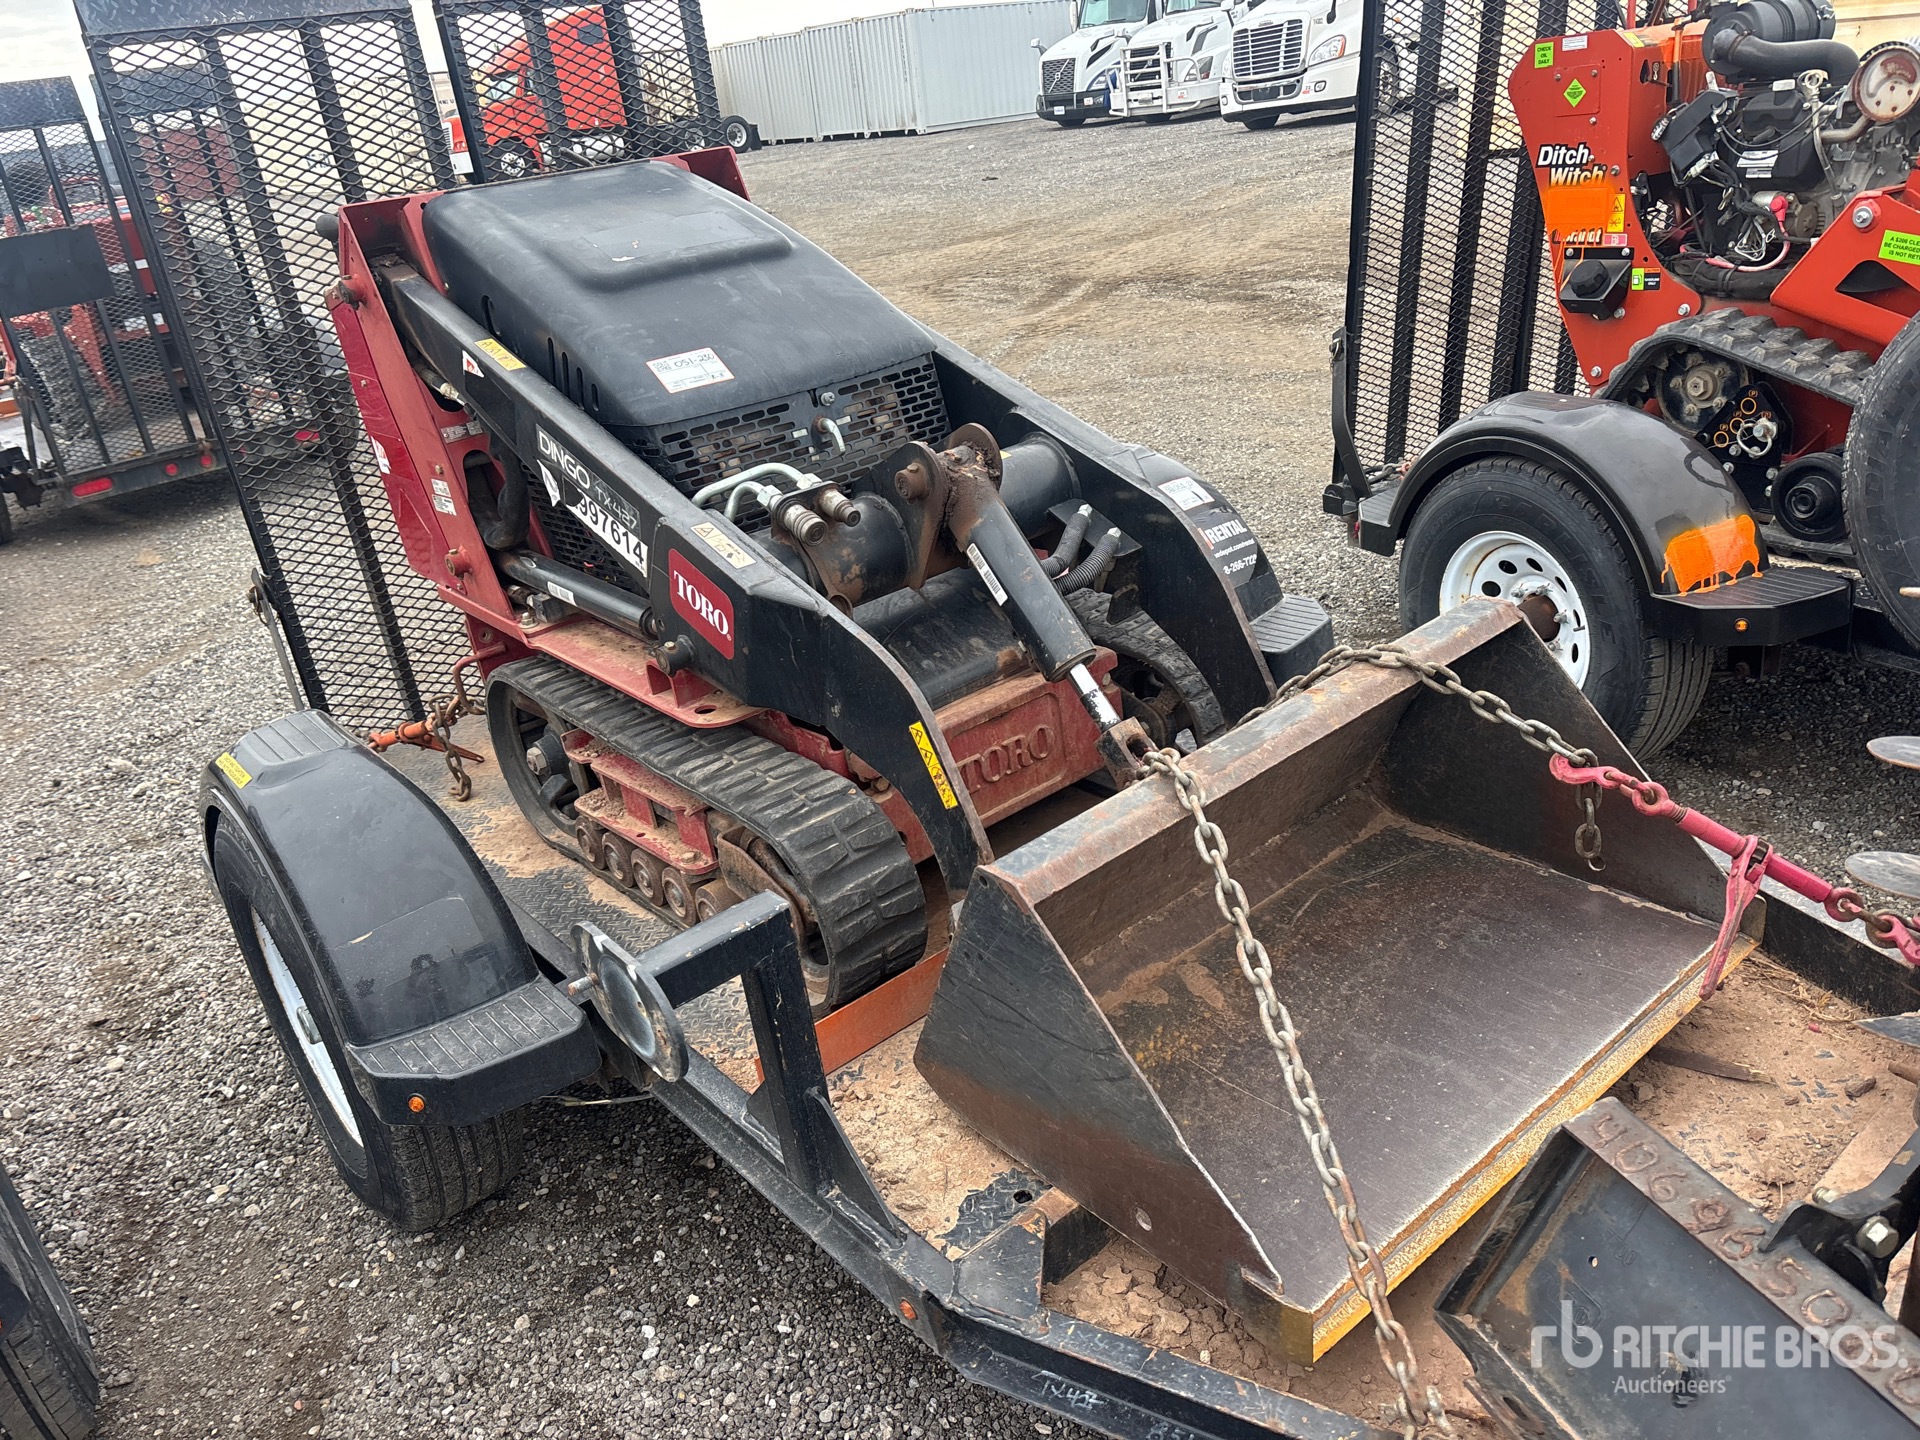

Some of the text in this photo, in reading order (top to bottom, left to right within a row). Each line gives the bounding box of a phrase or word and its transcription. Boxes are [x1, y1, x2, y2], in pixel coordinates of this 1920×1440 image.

[1537, 143, 1590, 167] Ditch
[1550, 164, 1606, 187] Witch
[538, 430, 591, 490] DINGO
[1204, 519, 1248, 544] RENTAL
[673, 569, 729, 635] TORO
[957, 724, 1055, 796] TORO
